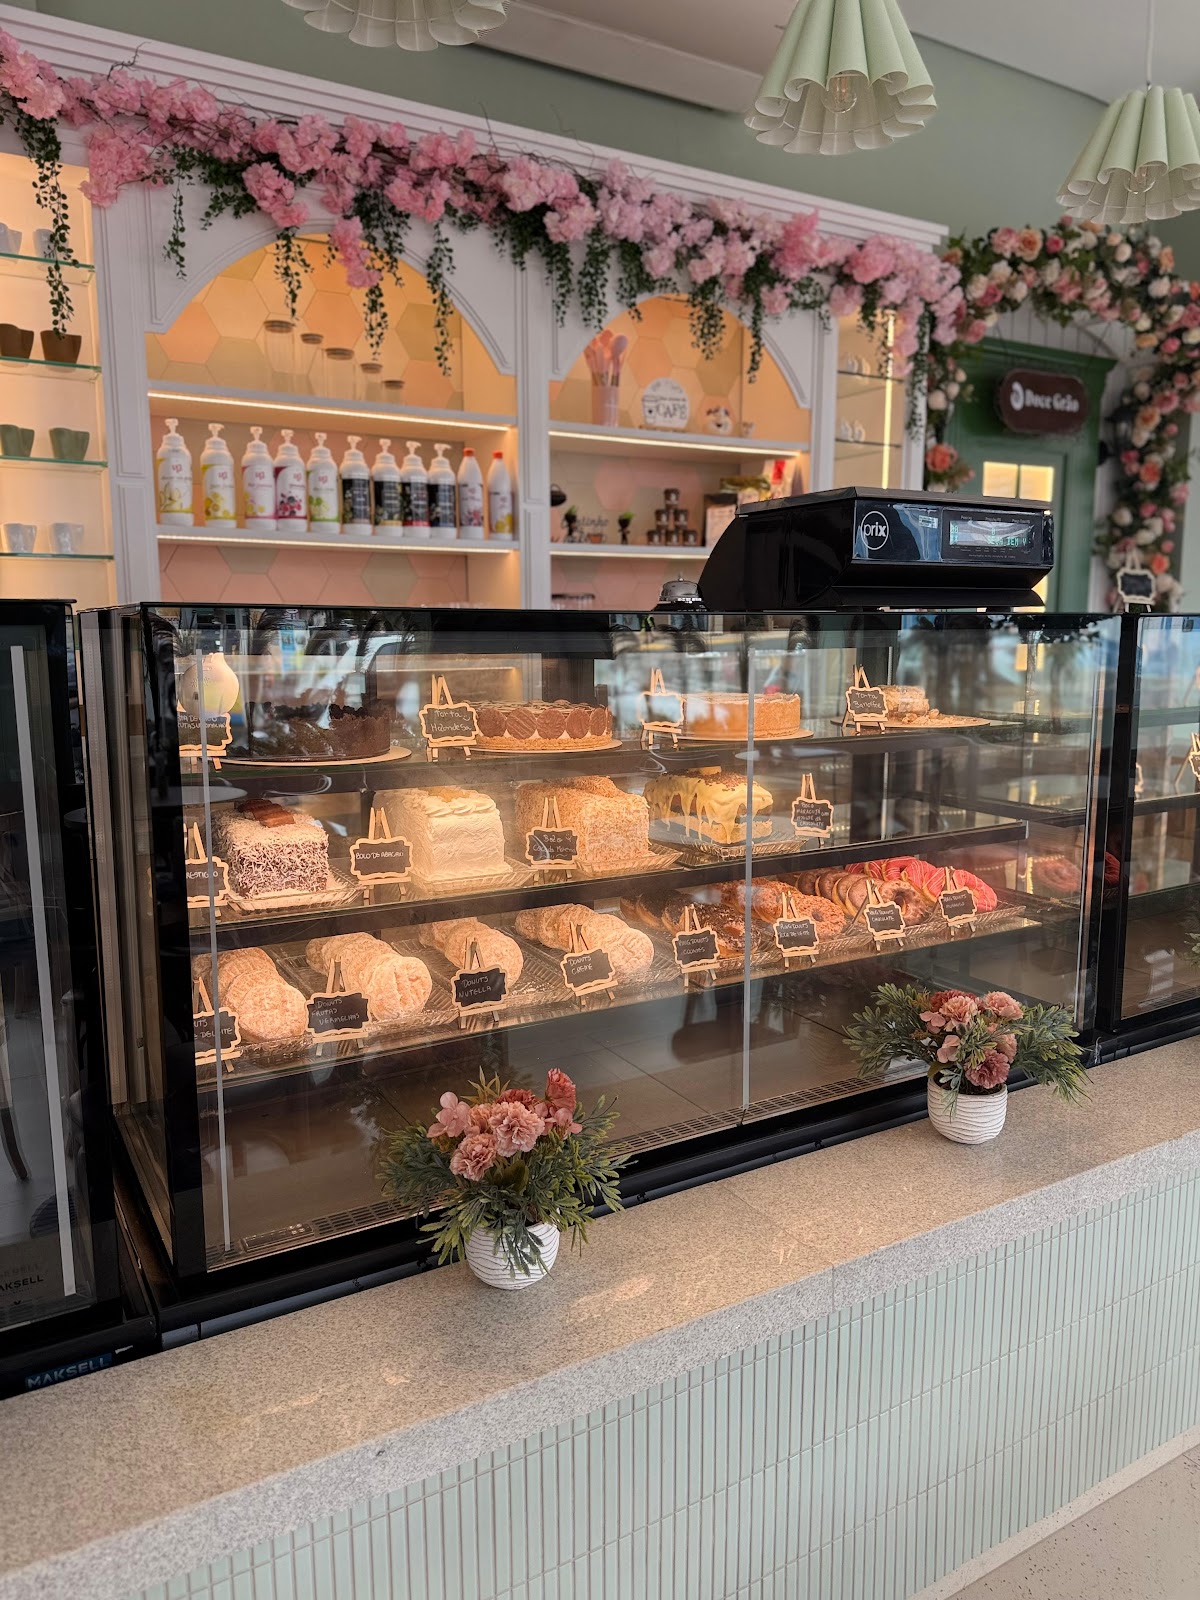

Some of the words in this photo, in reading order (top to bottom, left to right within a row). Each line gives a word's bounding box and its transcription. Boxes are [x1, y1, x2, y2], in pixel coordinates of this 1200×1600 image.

[1025, 388, 1052, 409] Doce
[863, 521, 887, 538] prix
[434, 710, 463, 718] Torta
[356, 852, 371, 860] BOLO
[568, 955, 592, 966] DONUTS
[461, 975, 489, 988] DONUTS
[458, 985, 492, 998] NUTELLA
[316, 998, 343, 1009] DONUTS
[311, 1007, 338, 1017] FRUTAS
[27, 1357, 109, 1389] MAKSELL
